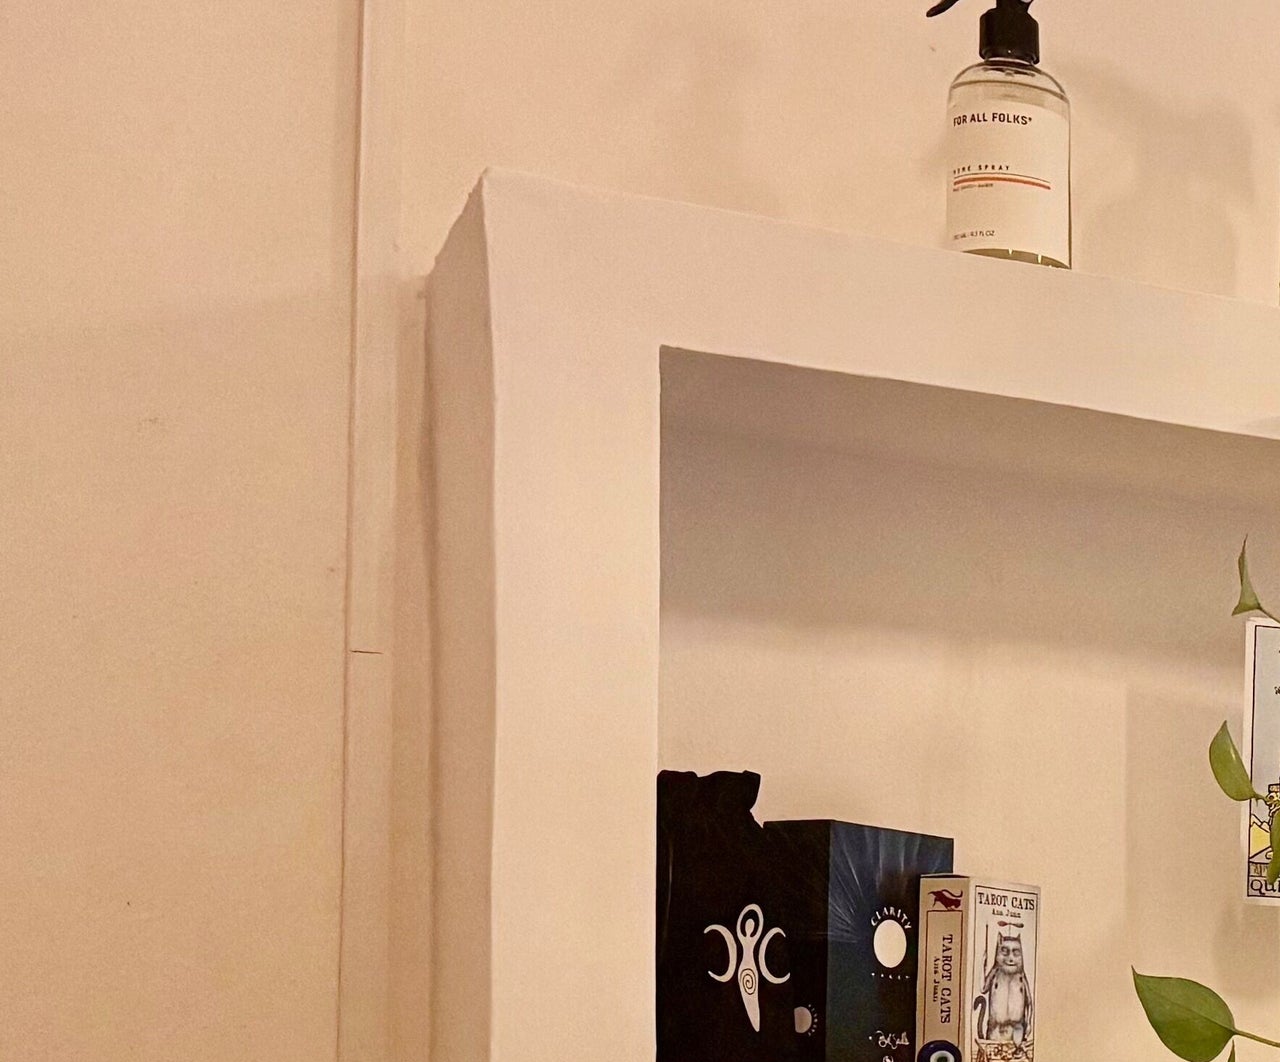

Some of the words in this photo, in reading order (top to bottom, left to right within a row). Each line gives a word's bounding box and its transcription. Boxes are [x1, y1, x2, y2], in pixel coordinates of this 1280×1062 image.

[953, 114, 968, 127] FOR
[970, 112, 988, 123] ALL
[977, 892, 1009, 907] TAROT
[1011, 896, 1036, 911] CATS
[870, 906, 912, 931] CLARITY
[941, 934, 953, 982] TAROT
[940, 987, 952, 1024] CATS
